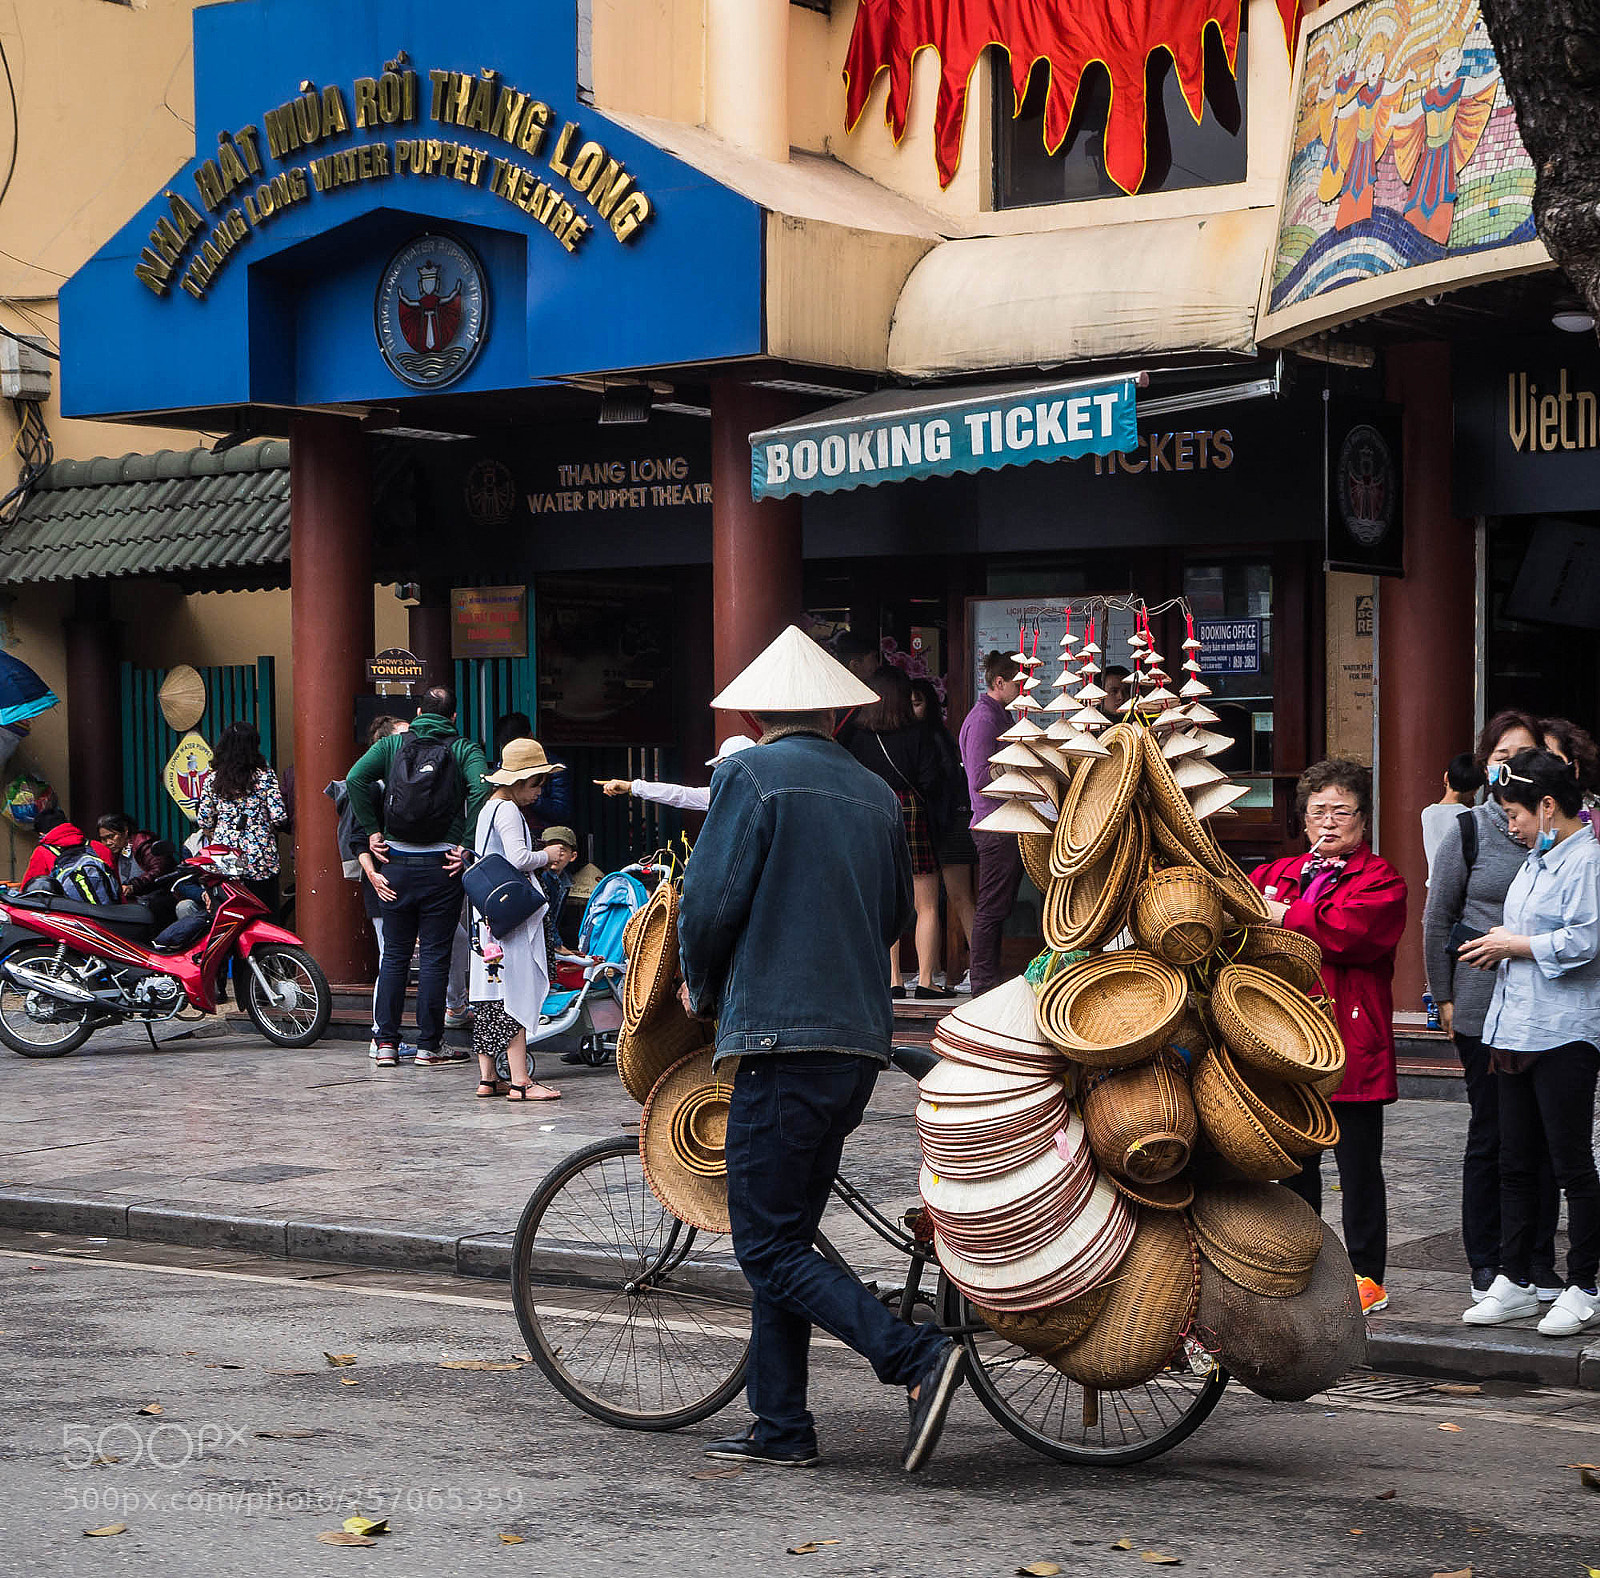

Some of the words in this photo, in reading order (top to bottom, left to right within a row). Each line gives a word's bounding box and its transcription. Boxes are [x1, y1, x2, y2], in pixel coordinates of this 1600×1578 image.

[135, 189, 204, 295] NHÀ
[429, 67, 553, 156] THĂNG
[549, 121, 655, 244] LONG
[180, 207, 249, 299] THANG
[243, 166, 308, 226] LONG
[309, 142, 390, 192] WATER
[394, 139, 488, 186] PUPPET
[489, 157, 593, 253] THEATRE
[766, 424, 951, 485] BOOKING
[964, 392, 1119, 456] TICKET
[557, 461, 627, 487] THANG
[630, 457, 689, 482] LONG
[527, 492, 584, 514] WATER
[588, 486, 648, 510] PUPPET
[1200, 625, 1232, 640] BOOKING
[1232, 624, 1256, 639] OFFICE
[370, 665, 422, 675] TONIGHT!
[377, 658, 403, 666] SHOW'S
